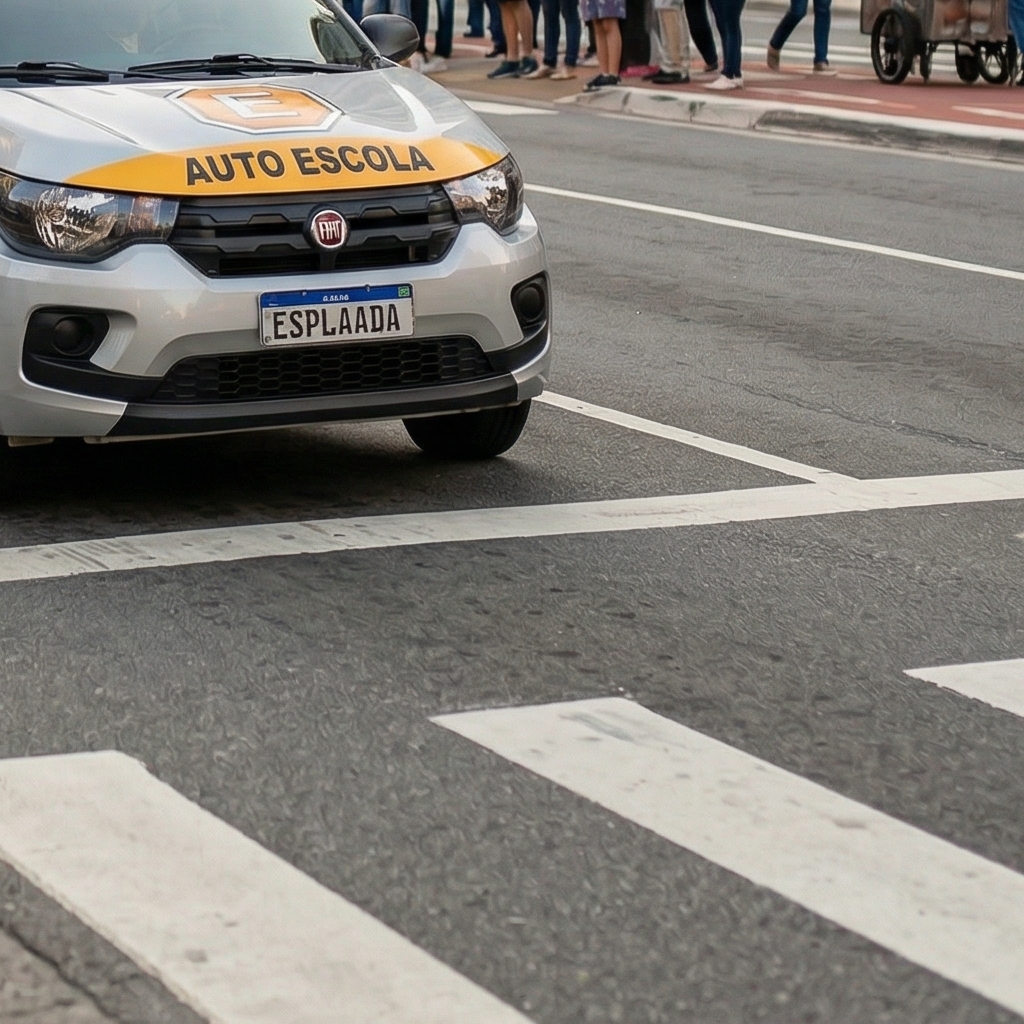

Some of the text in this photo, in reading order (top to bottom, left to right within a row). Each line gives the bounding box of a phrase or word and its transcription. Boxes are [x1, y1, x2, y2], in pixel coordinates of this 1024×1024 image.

[209, 91, 301, 119] E
[186, 144, 436, 186] AUTO ESCOLA
[273, 303, 401, 340] ESPLAADA
